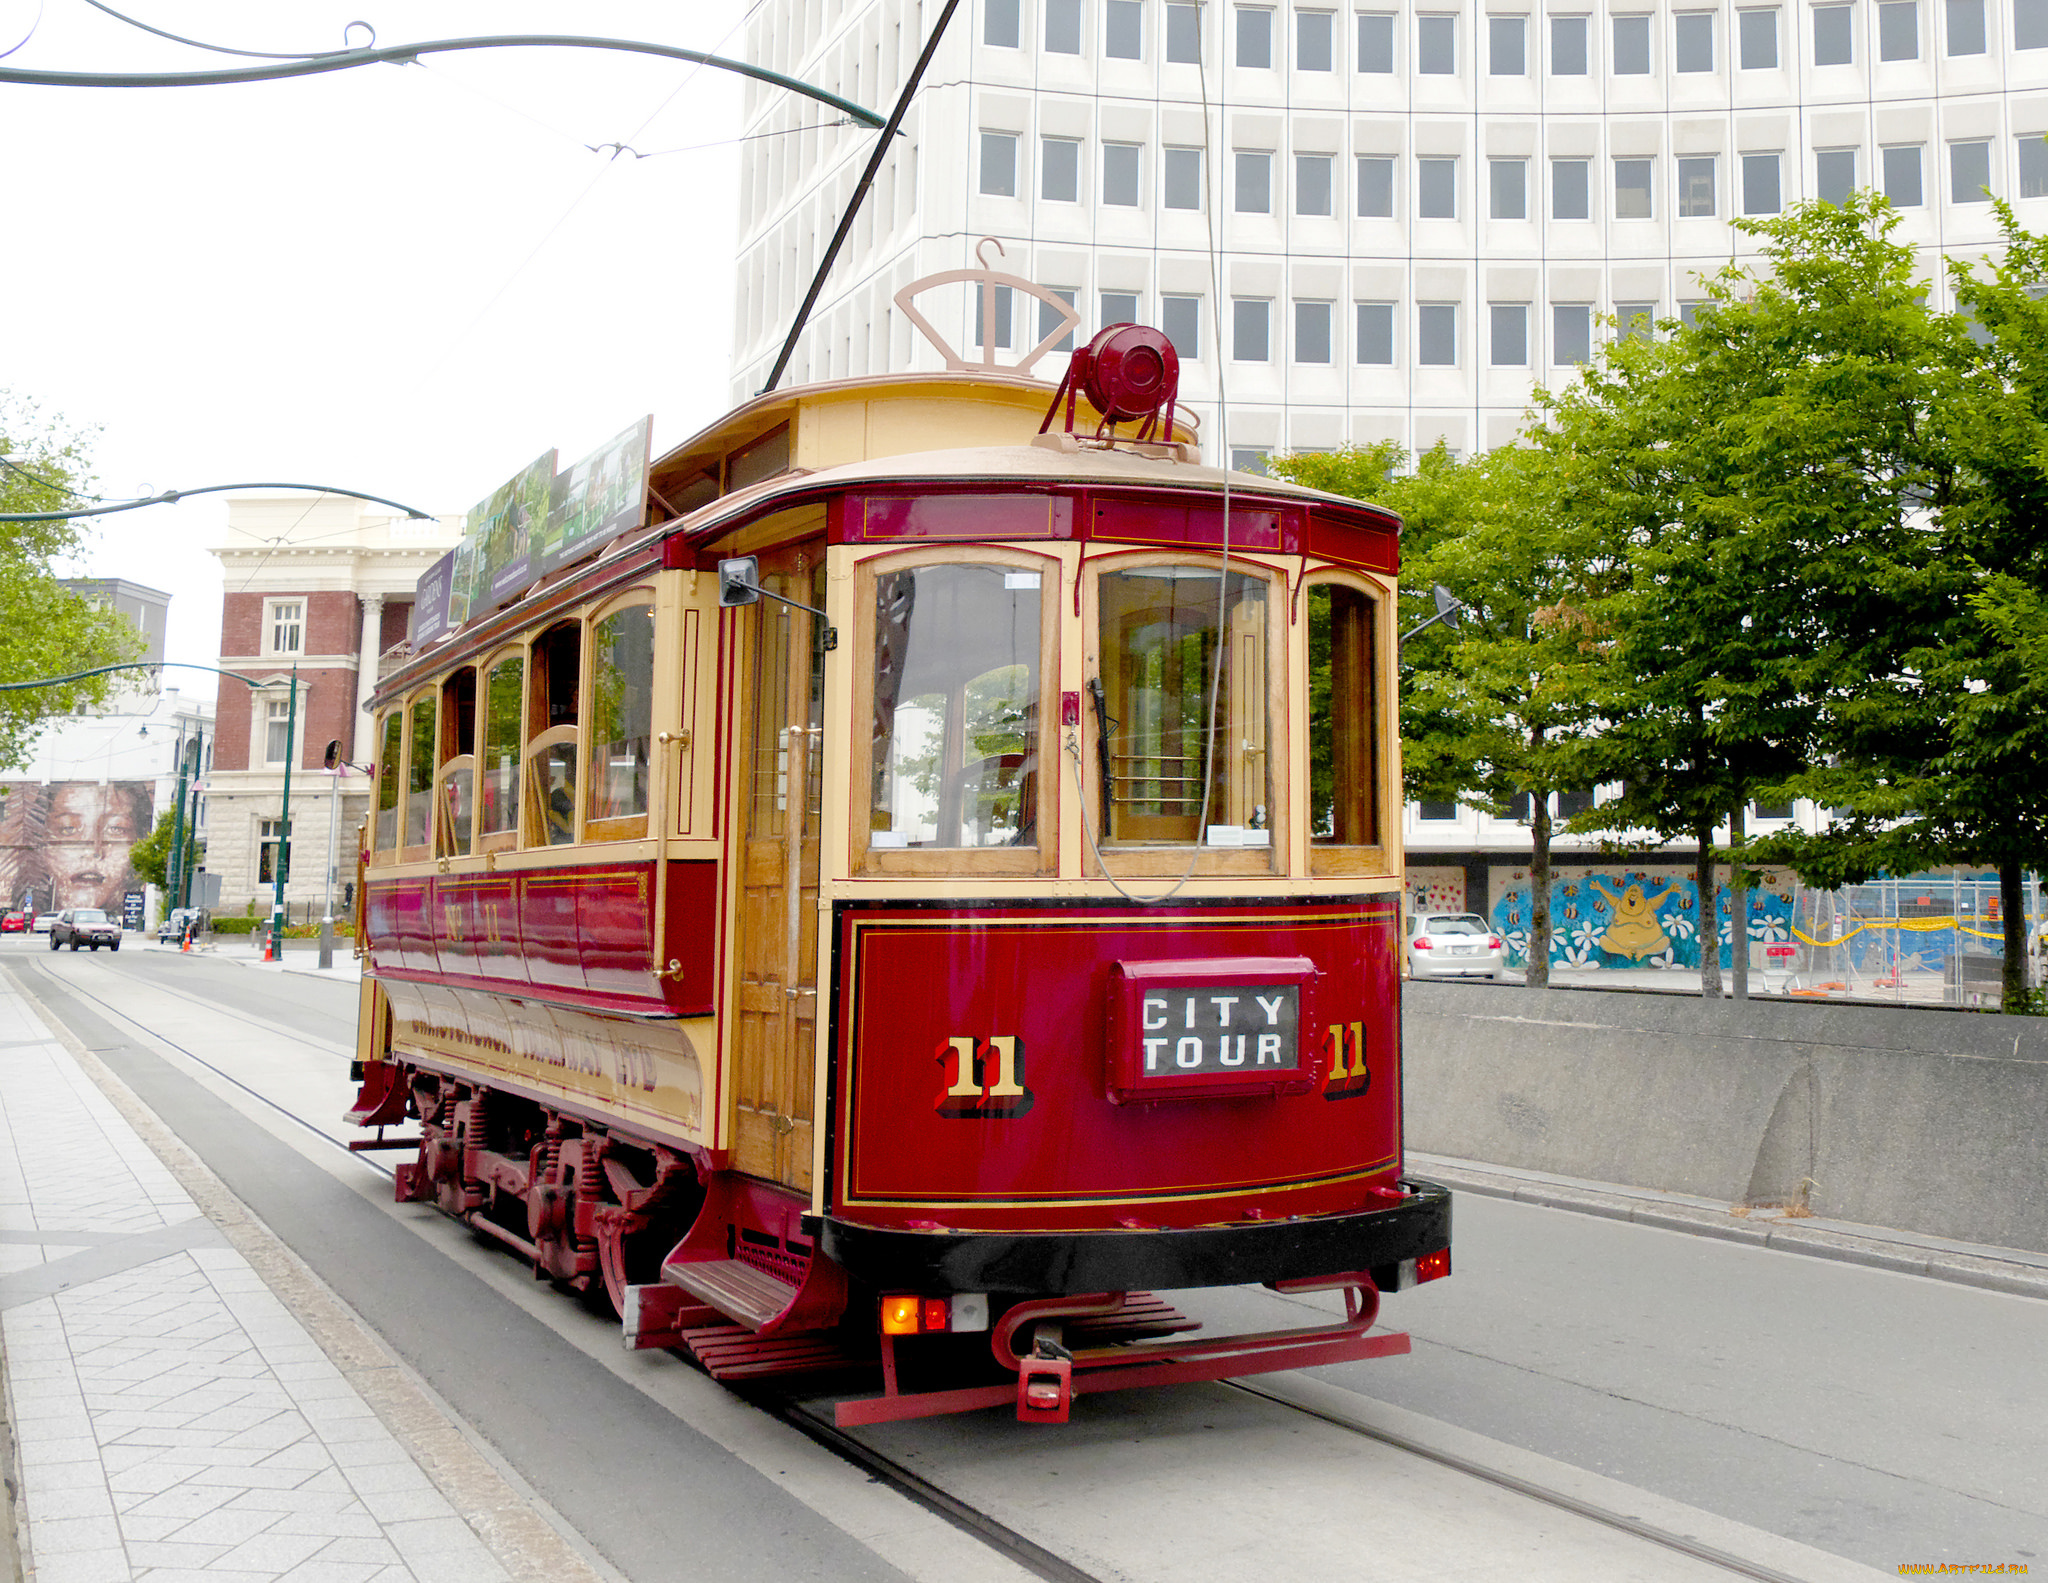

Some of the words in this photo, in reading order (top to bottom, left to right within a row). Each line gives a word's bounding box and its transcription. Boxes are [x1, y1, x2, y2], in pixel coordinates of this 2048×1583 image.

[1142, 996, 1284, 1030] CITY
[938, 1036, 1028, 1106] 11
[1142, 1034, 1282, 1070] TOUR
[1324, 1021, 1369, 1090] 11
